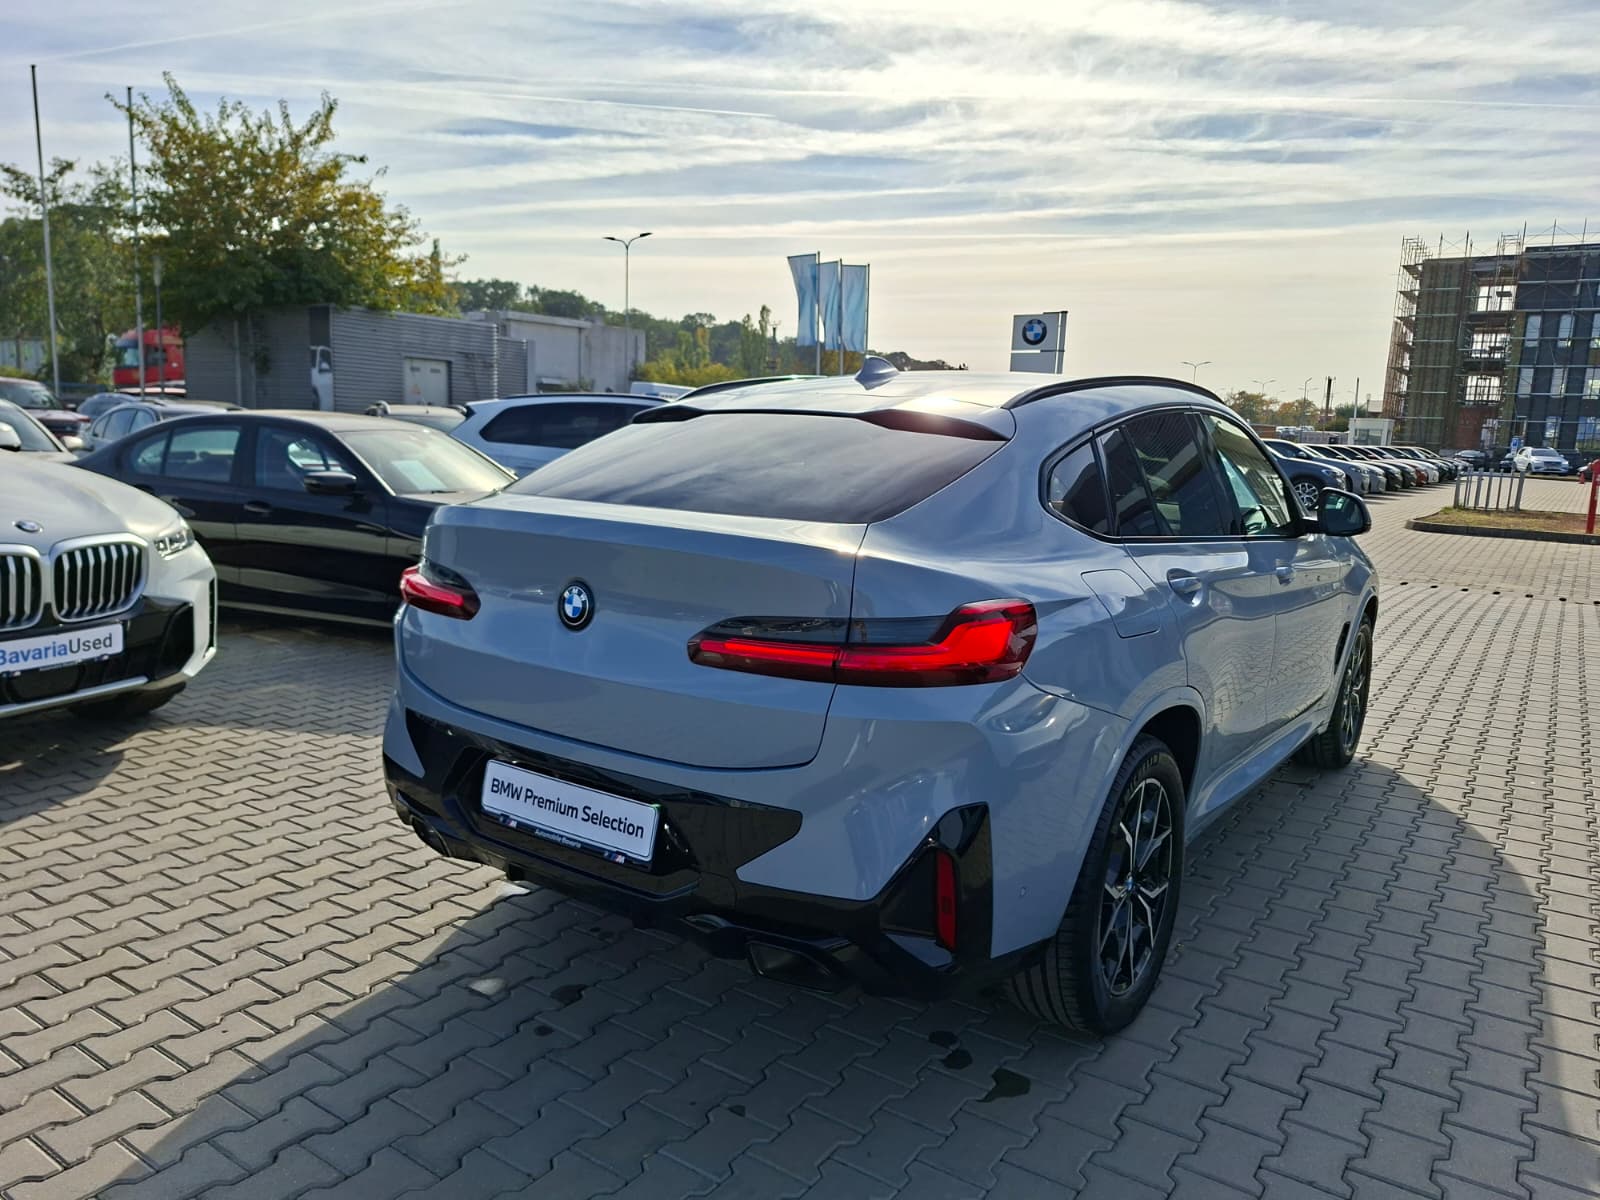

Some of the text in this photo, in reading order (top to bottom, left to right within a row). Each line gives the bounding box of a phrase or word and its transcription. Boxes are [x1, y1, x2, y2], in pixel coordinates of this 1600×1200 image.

[491, 778, 522, 801] BMW
[524, 788, 579, 819] Premium
[581, 806, 645, 839] Selection
